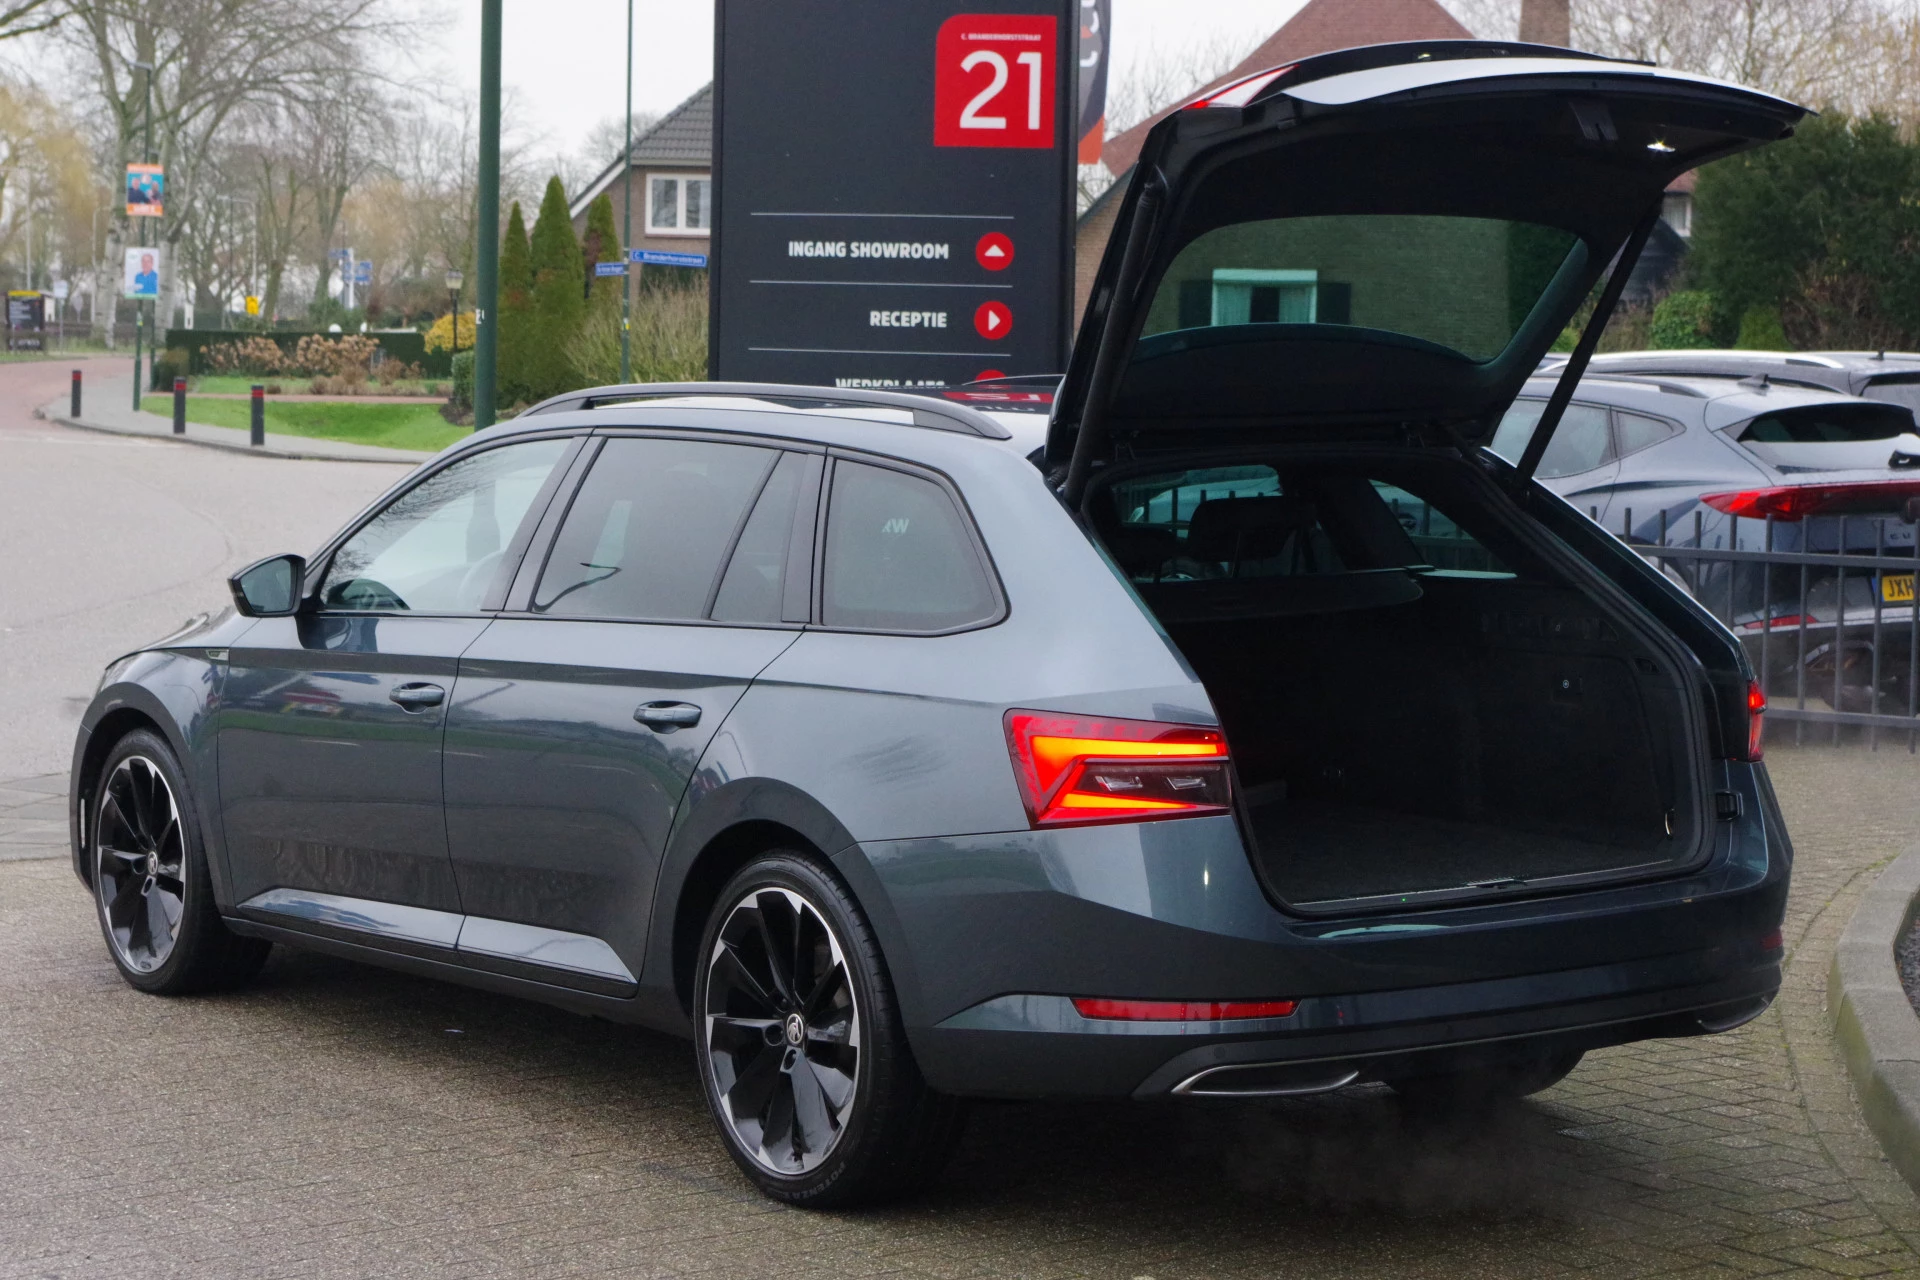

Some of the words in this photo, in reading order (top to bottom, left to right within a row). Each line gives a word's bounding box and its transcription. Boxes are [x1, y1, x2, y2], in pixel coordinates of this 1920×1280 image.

[960, 50, 1042, 130] 21
[788, 240, 846, 257] INGANG
[850, 241, 949, 259] SHOWROOM
[869, 310, 948, 328] RECEPTIE
